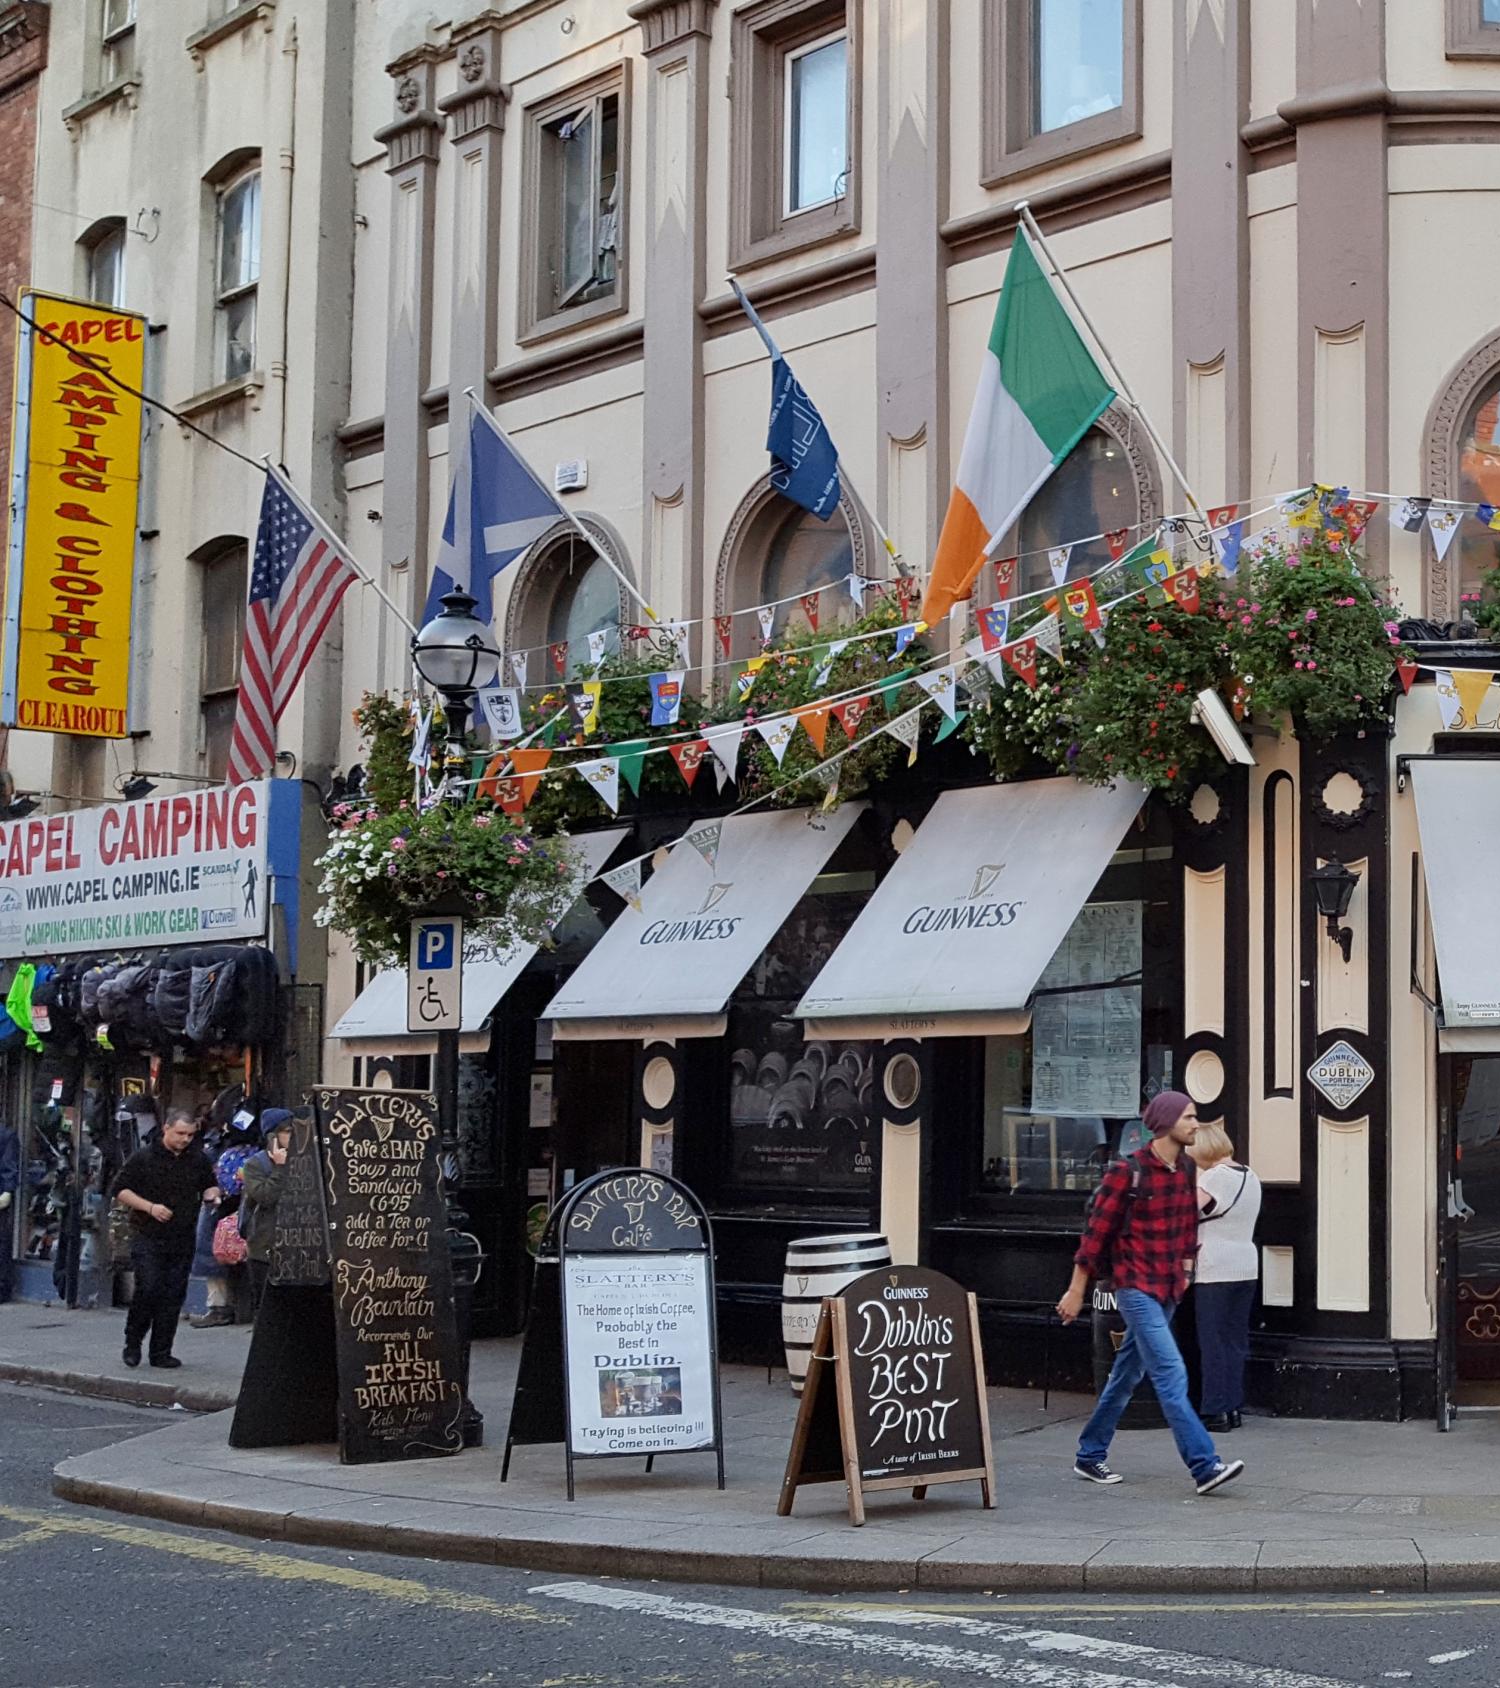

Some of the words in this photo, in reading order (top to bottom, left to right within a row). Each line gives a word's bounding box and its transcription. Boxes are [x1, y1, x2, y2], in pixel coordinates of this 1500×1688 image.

[38, 318, 142, 347] CAPEL
[52, 351, 122, 494] CAMPING
[46, 535, 104, 696] CLOTHING
[961, 667, 987, 688] 1916
[18, 699, 126, 735] CLEAROUT
[894, 717, 918, 734] 1916
[817, 761, 842, 777] 1916
[99, 787, 257, 866] CAMPING
[26, 876, 109, 912] WWW.CAPEL
[112, 865, 200, 900] CAMPING.IE
[25, 921, 68, 947] CAMPING
[68, 916, 104, 942] HIKING
[104, 914, 123, 939] SKI
[124, 915, 132, 937] &
[134, 909, 167, 935] WORK
[169, 907, 200, 934] GEAR
[903, 901, 1023, 934] GUINNESS
[639, 917, 743, 946] GUINNESS
[425, 930, 445, 963] P
[1324, 1054, 1360, 1065] GUINNESS
[1319, 1067, 1365, 1077] DUBLIN
[390, 1140, 425, 1160] BAR
[347, 1159, 386, 1176] Soup
[391, 1161, 422, 1177] and
[348, 1176, 422, 1194] Sandwich
[345, 1212, 370, 1229] add
[375, 1215, 385, 1229] a
[387, 1212, 411, 1229] Tea
[414, 1216, 431, 1229] or
[346, 1231, 387, 1249] Coffee
[390, 1231, 415, 1249] for
[351, 1265, 433, 1299] Anthony
[574, 1273, 695, 1284] SLATTERY'S
[883, 1286, 929, 1300] GUINNESS
[1092, 1288, 1118, 1311] GUIN
[350, 1291, 435, 1327] Bourdain
[576, 1304, 595, 1316] The
[596, 1304, 622, 1316] Home
[623, 1304, 635, 1318] of
[635, 1303, 659, 1315] Irish
[659, 1302, 696, 1317] Coffee,
[416, 1326, 434, 1341] Our
[596, 1321, 654, 1335] Probably
[656, 1319, 678, 1331] the
[853, 1300, 953, 1357] Dublin's
[383, 1341, 425, 1363] FULL
[618, 1337, 644, 1349] Best
[647, 1337, 659, 1348] in
[364, 1359, 441, 1385] IRISH
[868, 1352, 952, 1400] BEST
[354, 1379, 447, 1410] BREAKFAST
[367, 1408, 395, 1428] Kids
[869, 1398, 960, 1448] PINT
[581, 1427, 625, 1439] Trying
[627, 1426, 637, 1436] is
[639, 1423, 693, 1435] believing
[608, 1439, 644, 1450] Come
[645, 1439, 661, 1447] on
